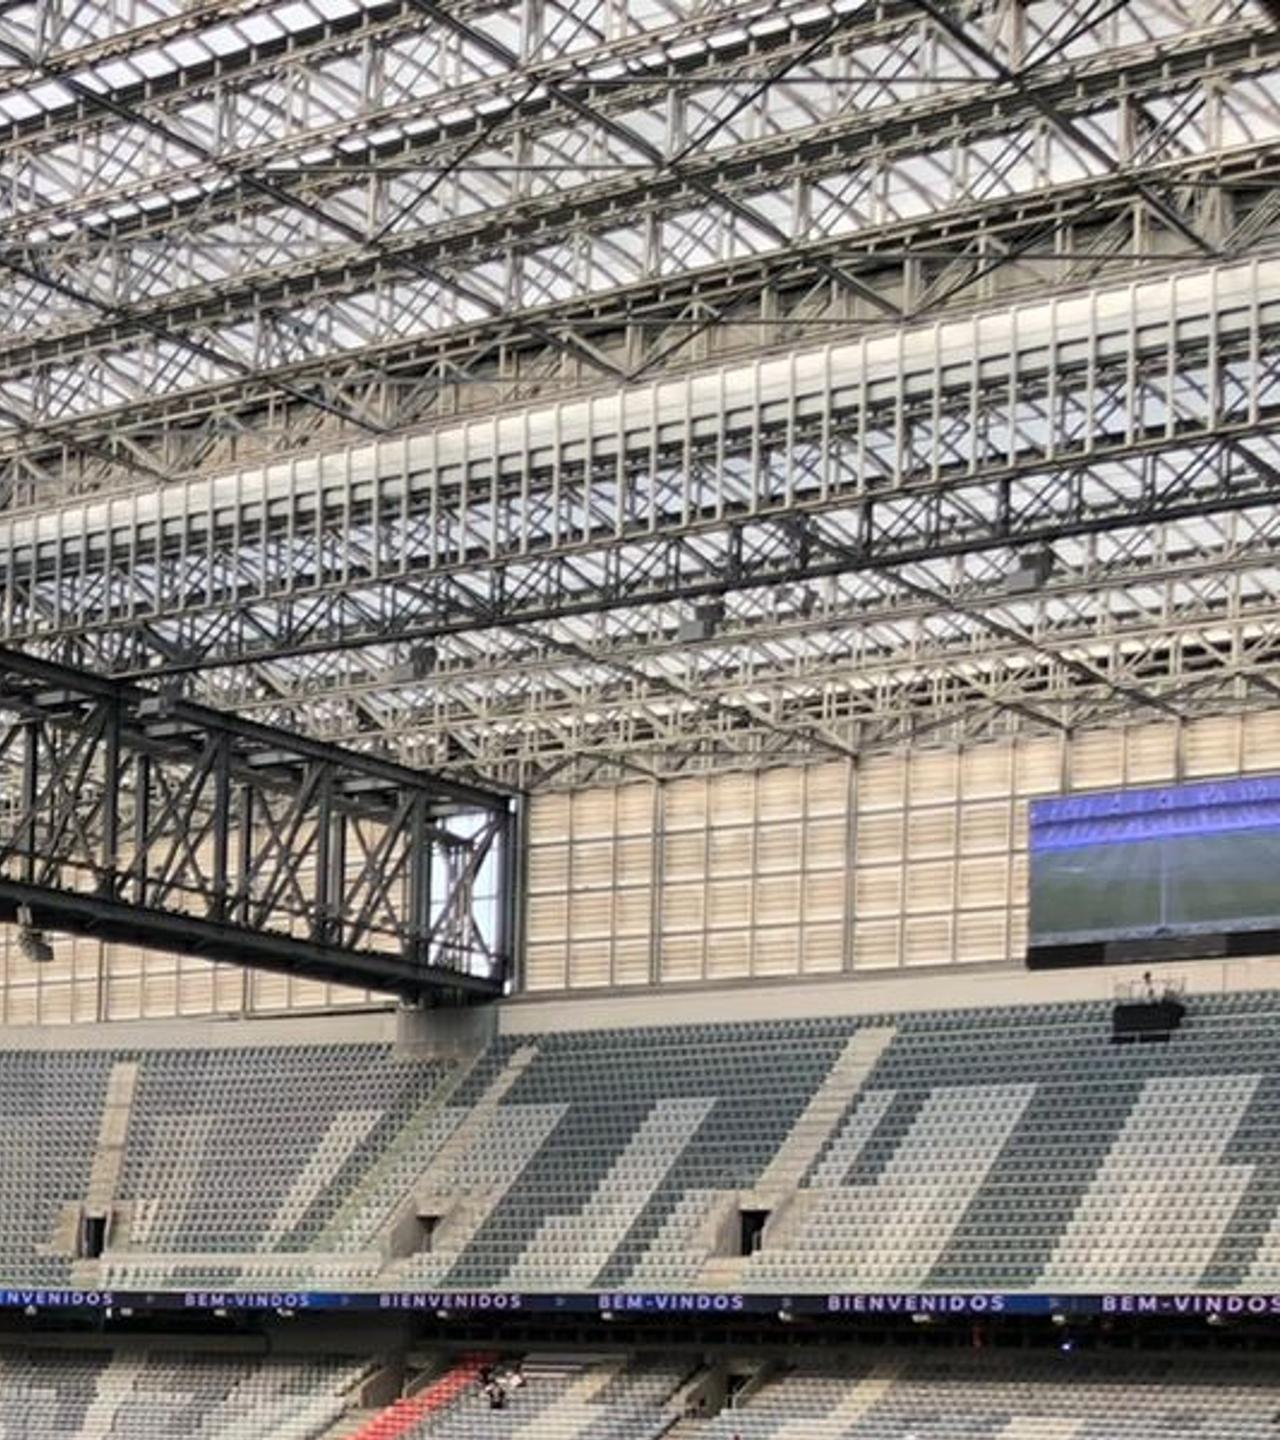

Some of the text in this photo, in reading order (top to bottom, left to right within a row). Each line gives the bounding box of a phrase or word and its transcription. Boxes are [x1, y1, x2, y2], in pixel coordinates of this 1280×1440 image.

[185, 1293, 309, 1307] BEM-VINDOS
[380, 1294, 521, 1309] BIENVENIDOS
[598, 1294, 743, 1310] BEM-VINDOS
[829, 1295, 1005, 1312] BIENVENIDOS
[1101, 1295, 1280, 1312] BEM-VINDOS
